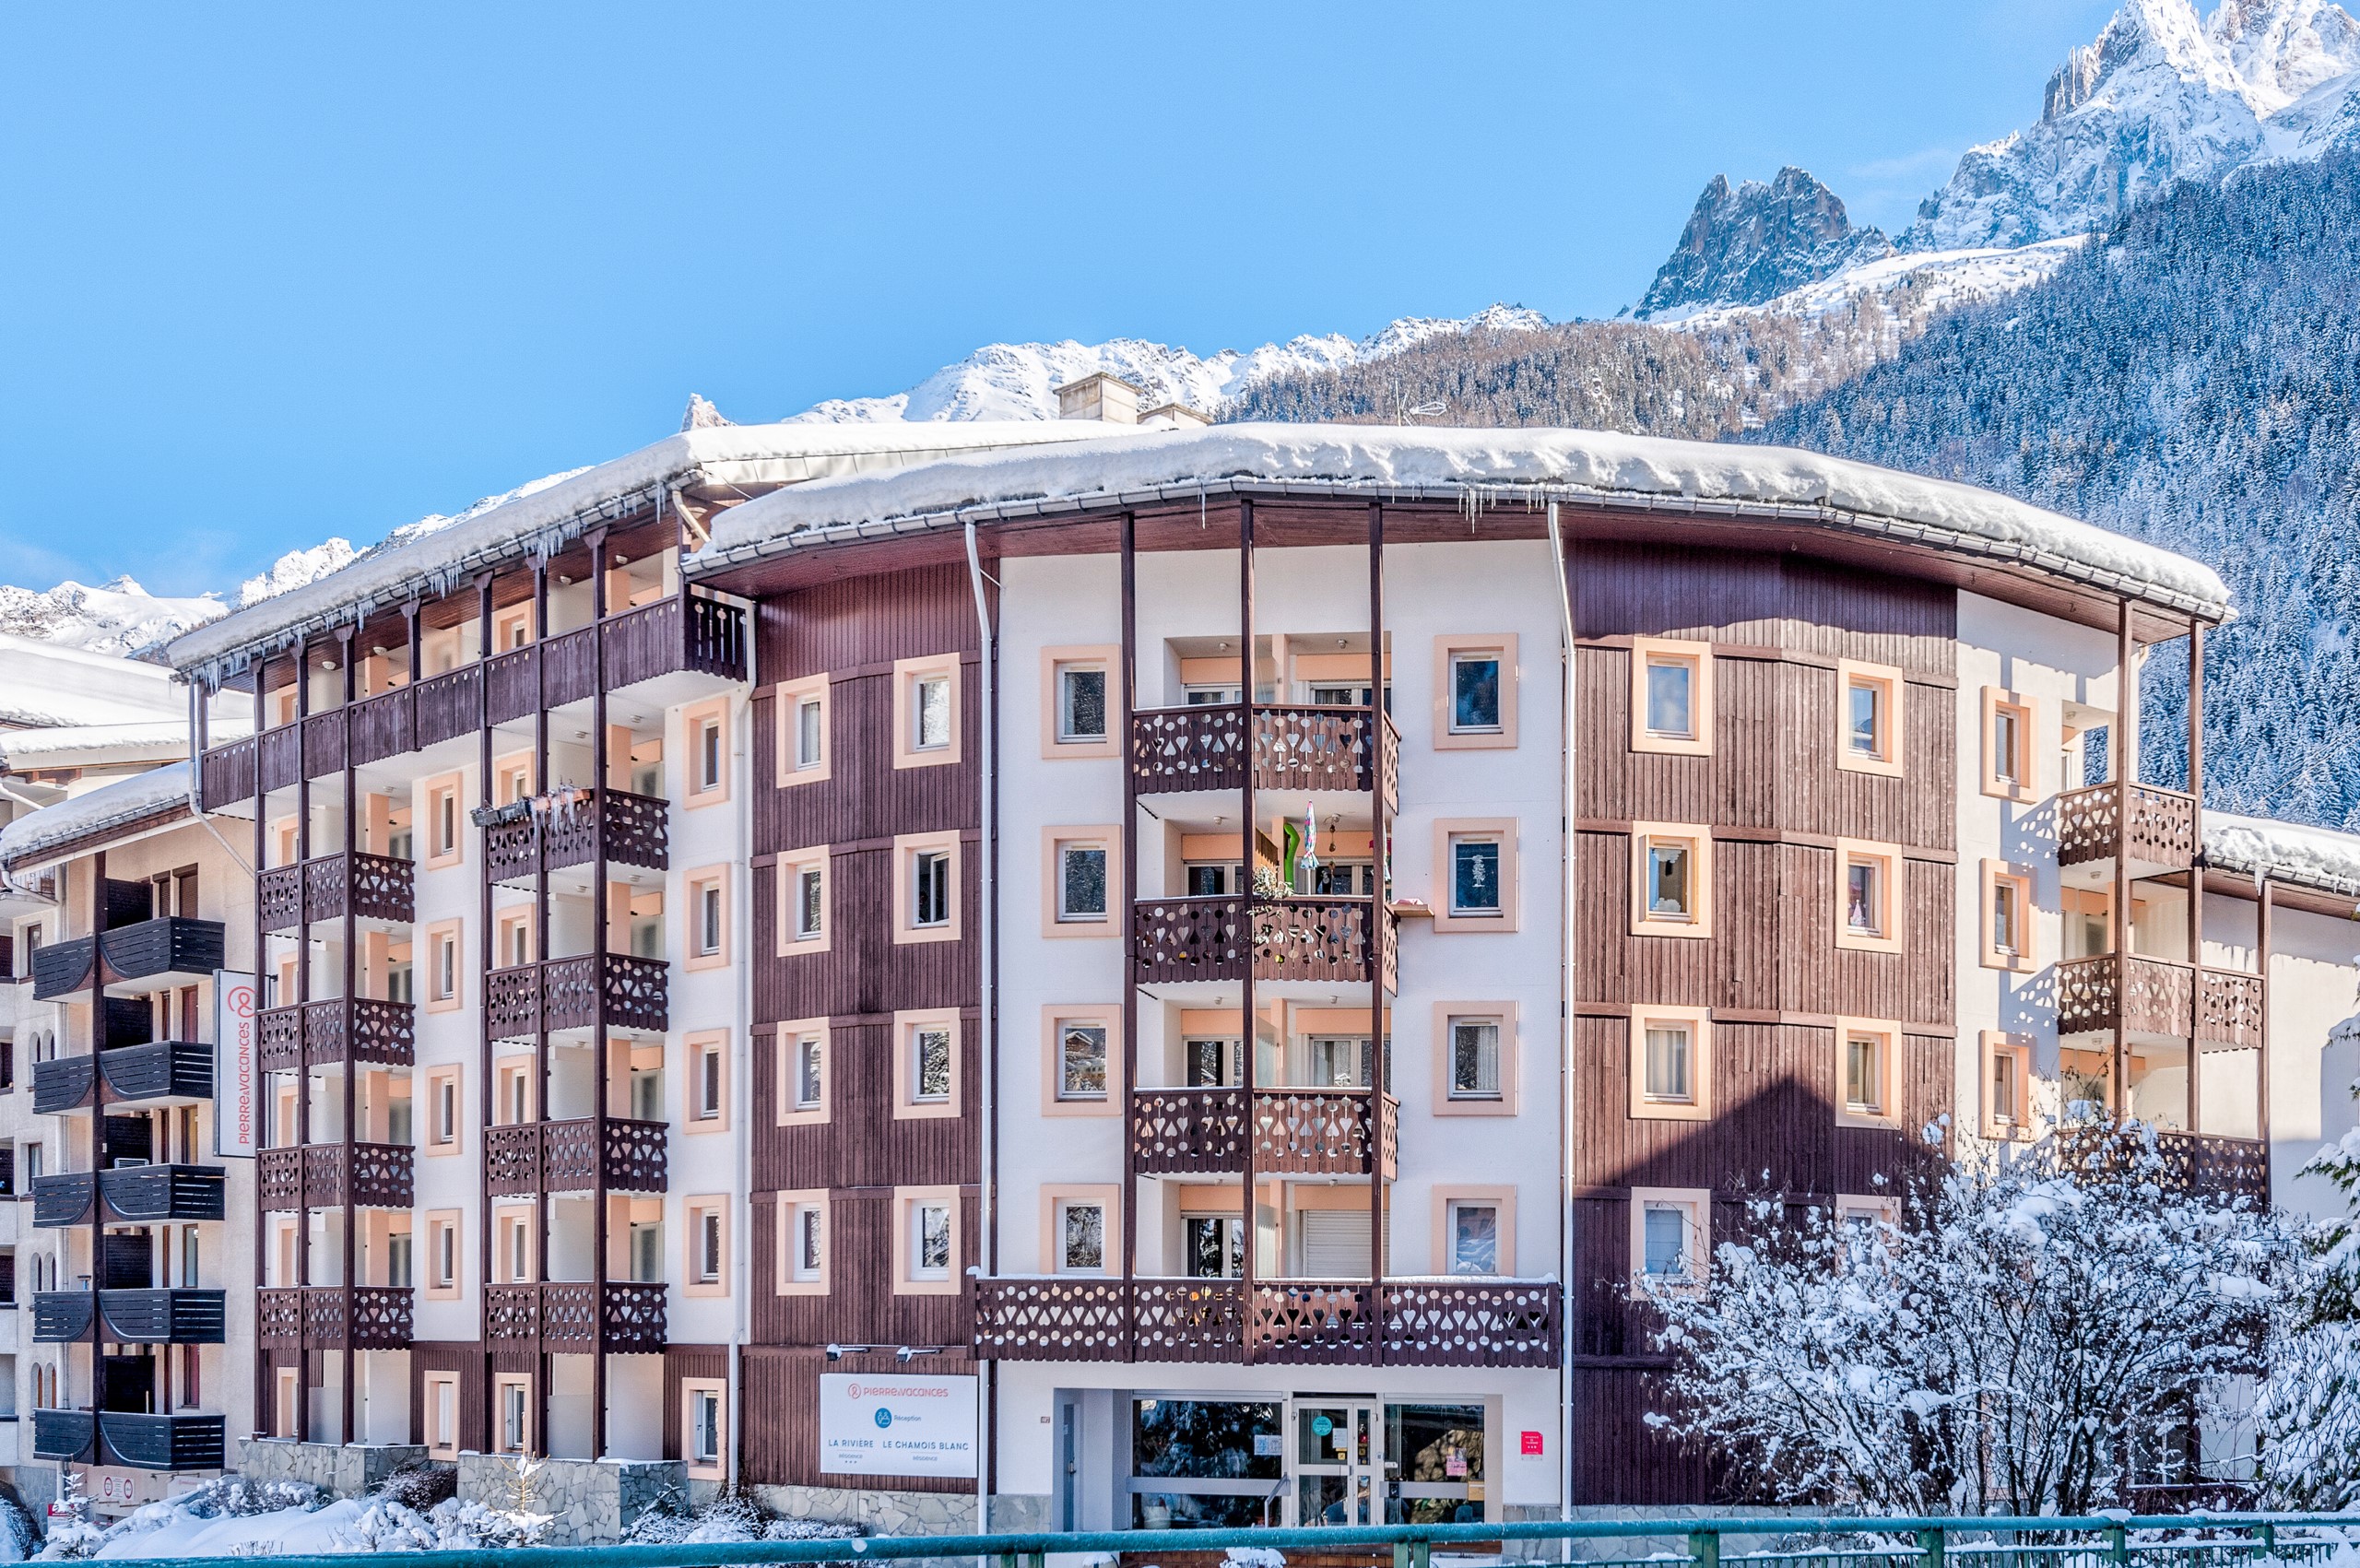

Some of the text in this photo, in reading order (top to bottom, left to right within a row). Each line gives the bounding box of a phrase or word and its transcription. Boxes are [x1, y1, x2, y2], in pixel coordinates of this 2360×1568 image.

[842, 1438, 874, 1448] RIVIÈRE
[895, 1441, 937, 1450] CHAMOIS
[938, 1442, 969, 1451] BLANC
